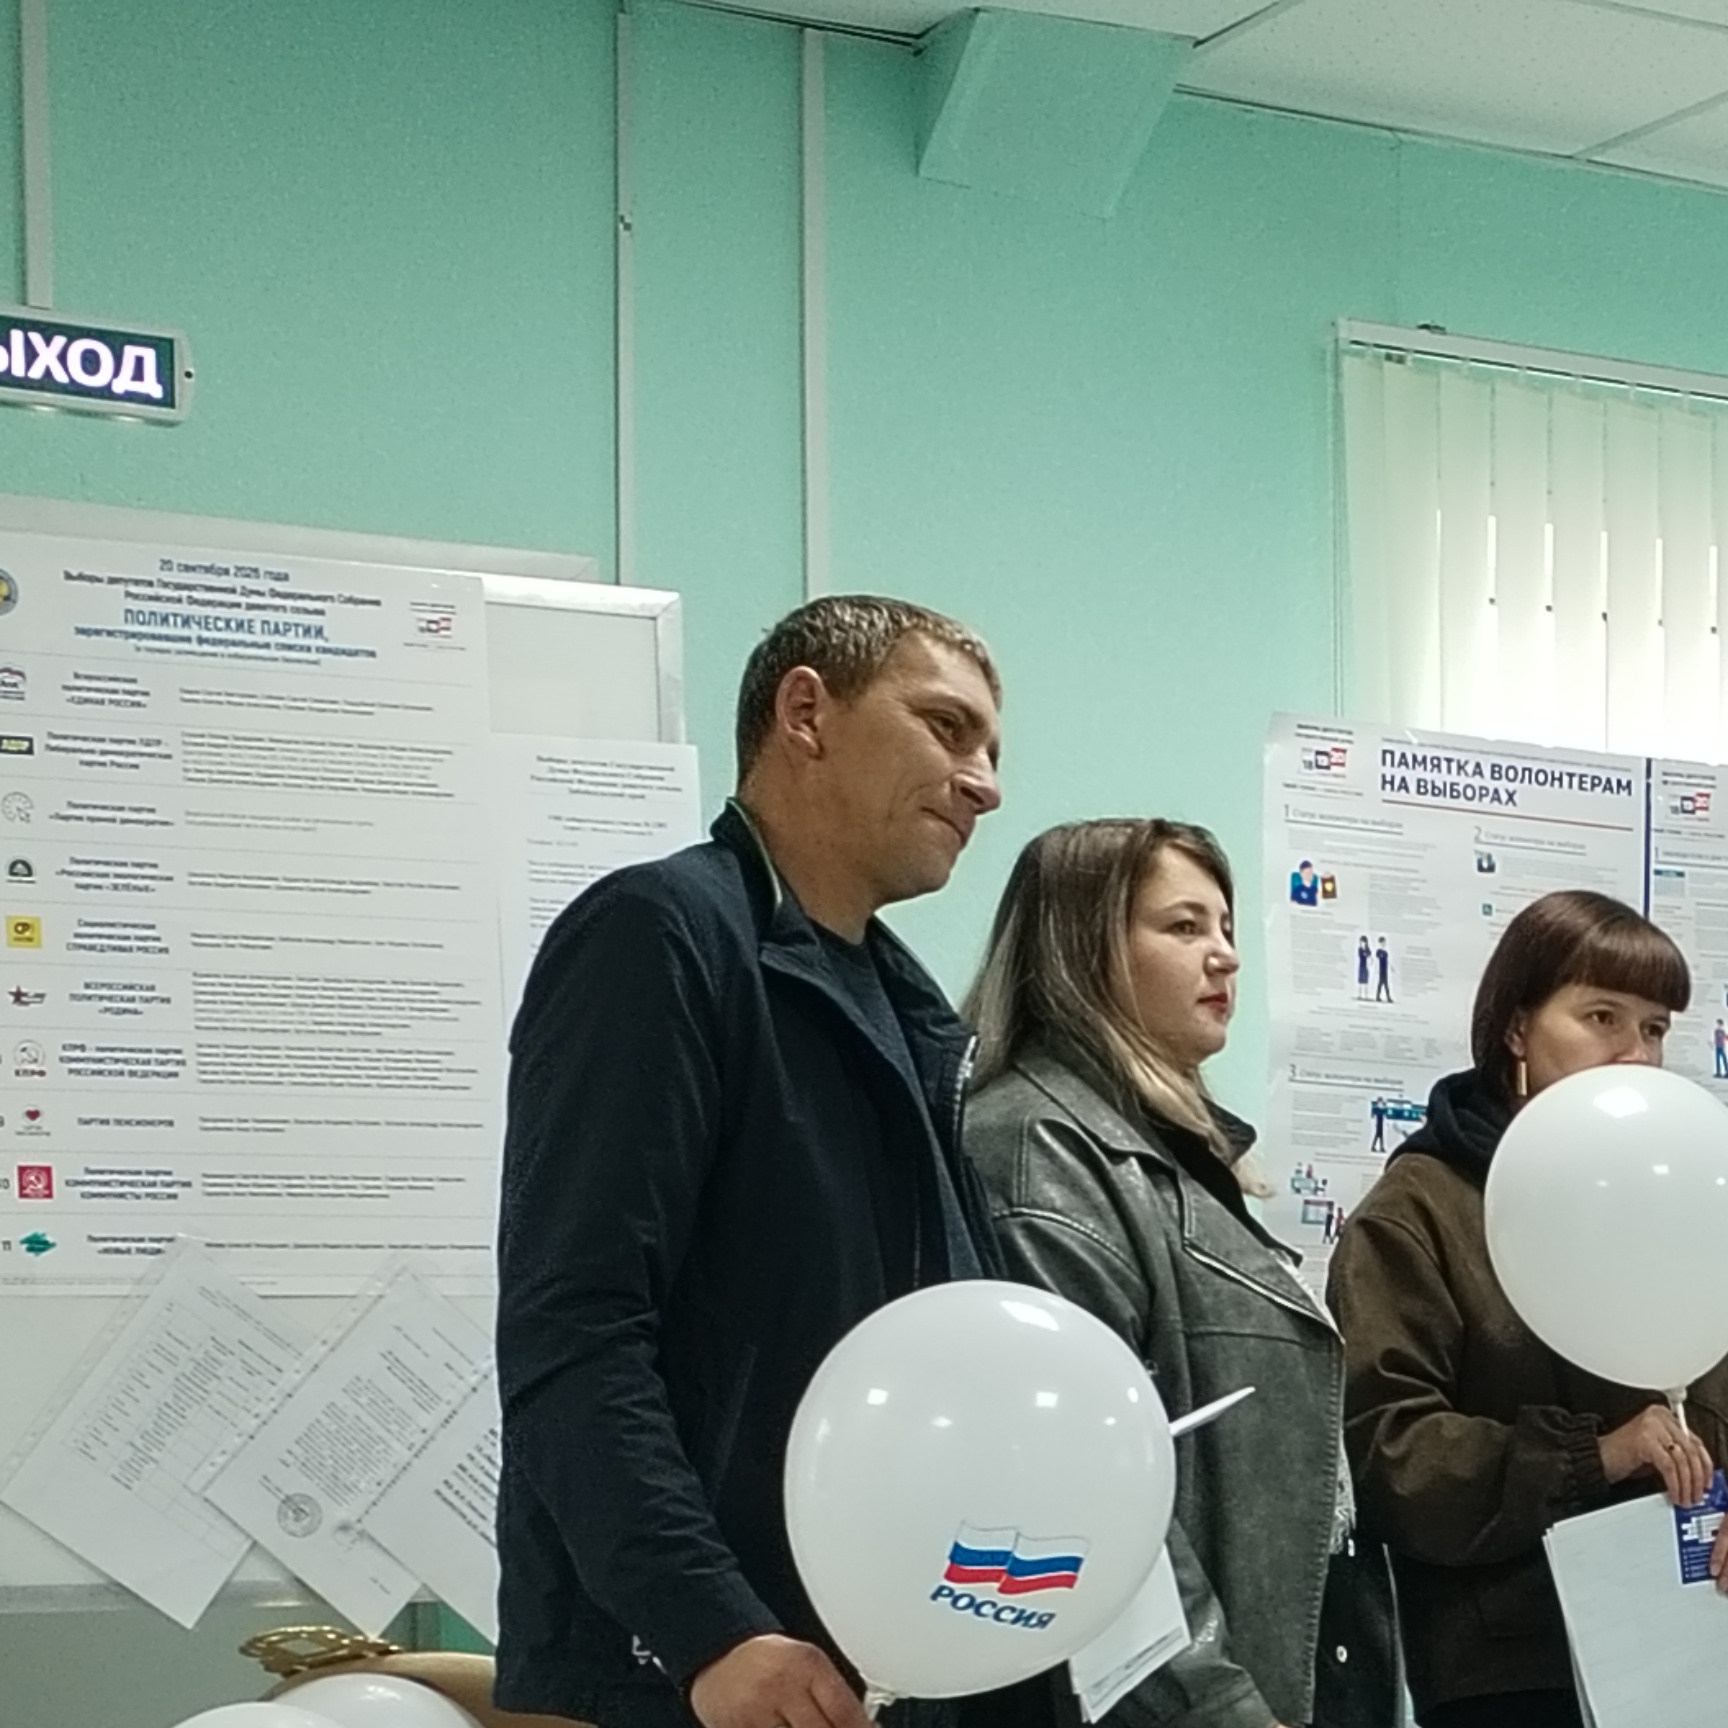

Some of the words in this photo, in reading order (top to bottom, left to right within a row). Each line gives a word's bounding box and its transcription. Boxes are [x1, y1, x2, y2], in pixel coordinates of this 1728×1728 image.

[159, 559, 173, 571] 20
[124, 608, 255, 635] ПОЛИТИЧЕСКИЕ
[261, 619, 329, 642] ПАРТИИ,
[1381, 749, 1485, 780] ПАМЯТКА
[1490, 763, 1633, 797] ВОЛОНТЕРАМ
[1381, 773, 1410, 794] НА
[1416, 778, 1518, 808] ВЫБОРАХ
[930, 1585, 1056, 1629] РОССИЯ
